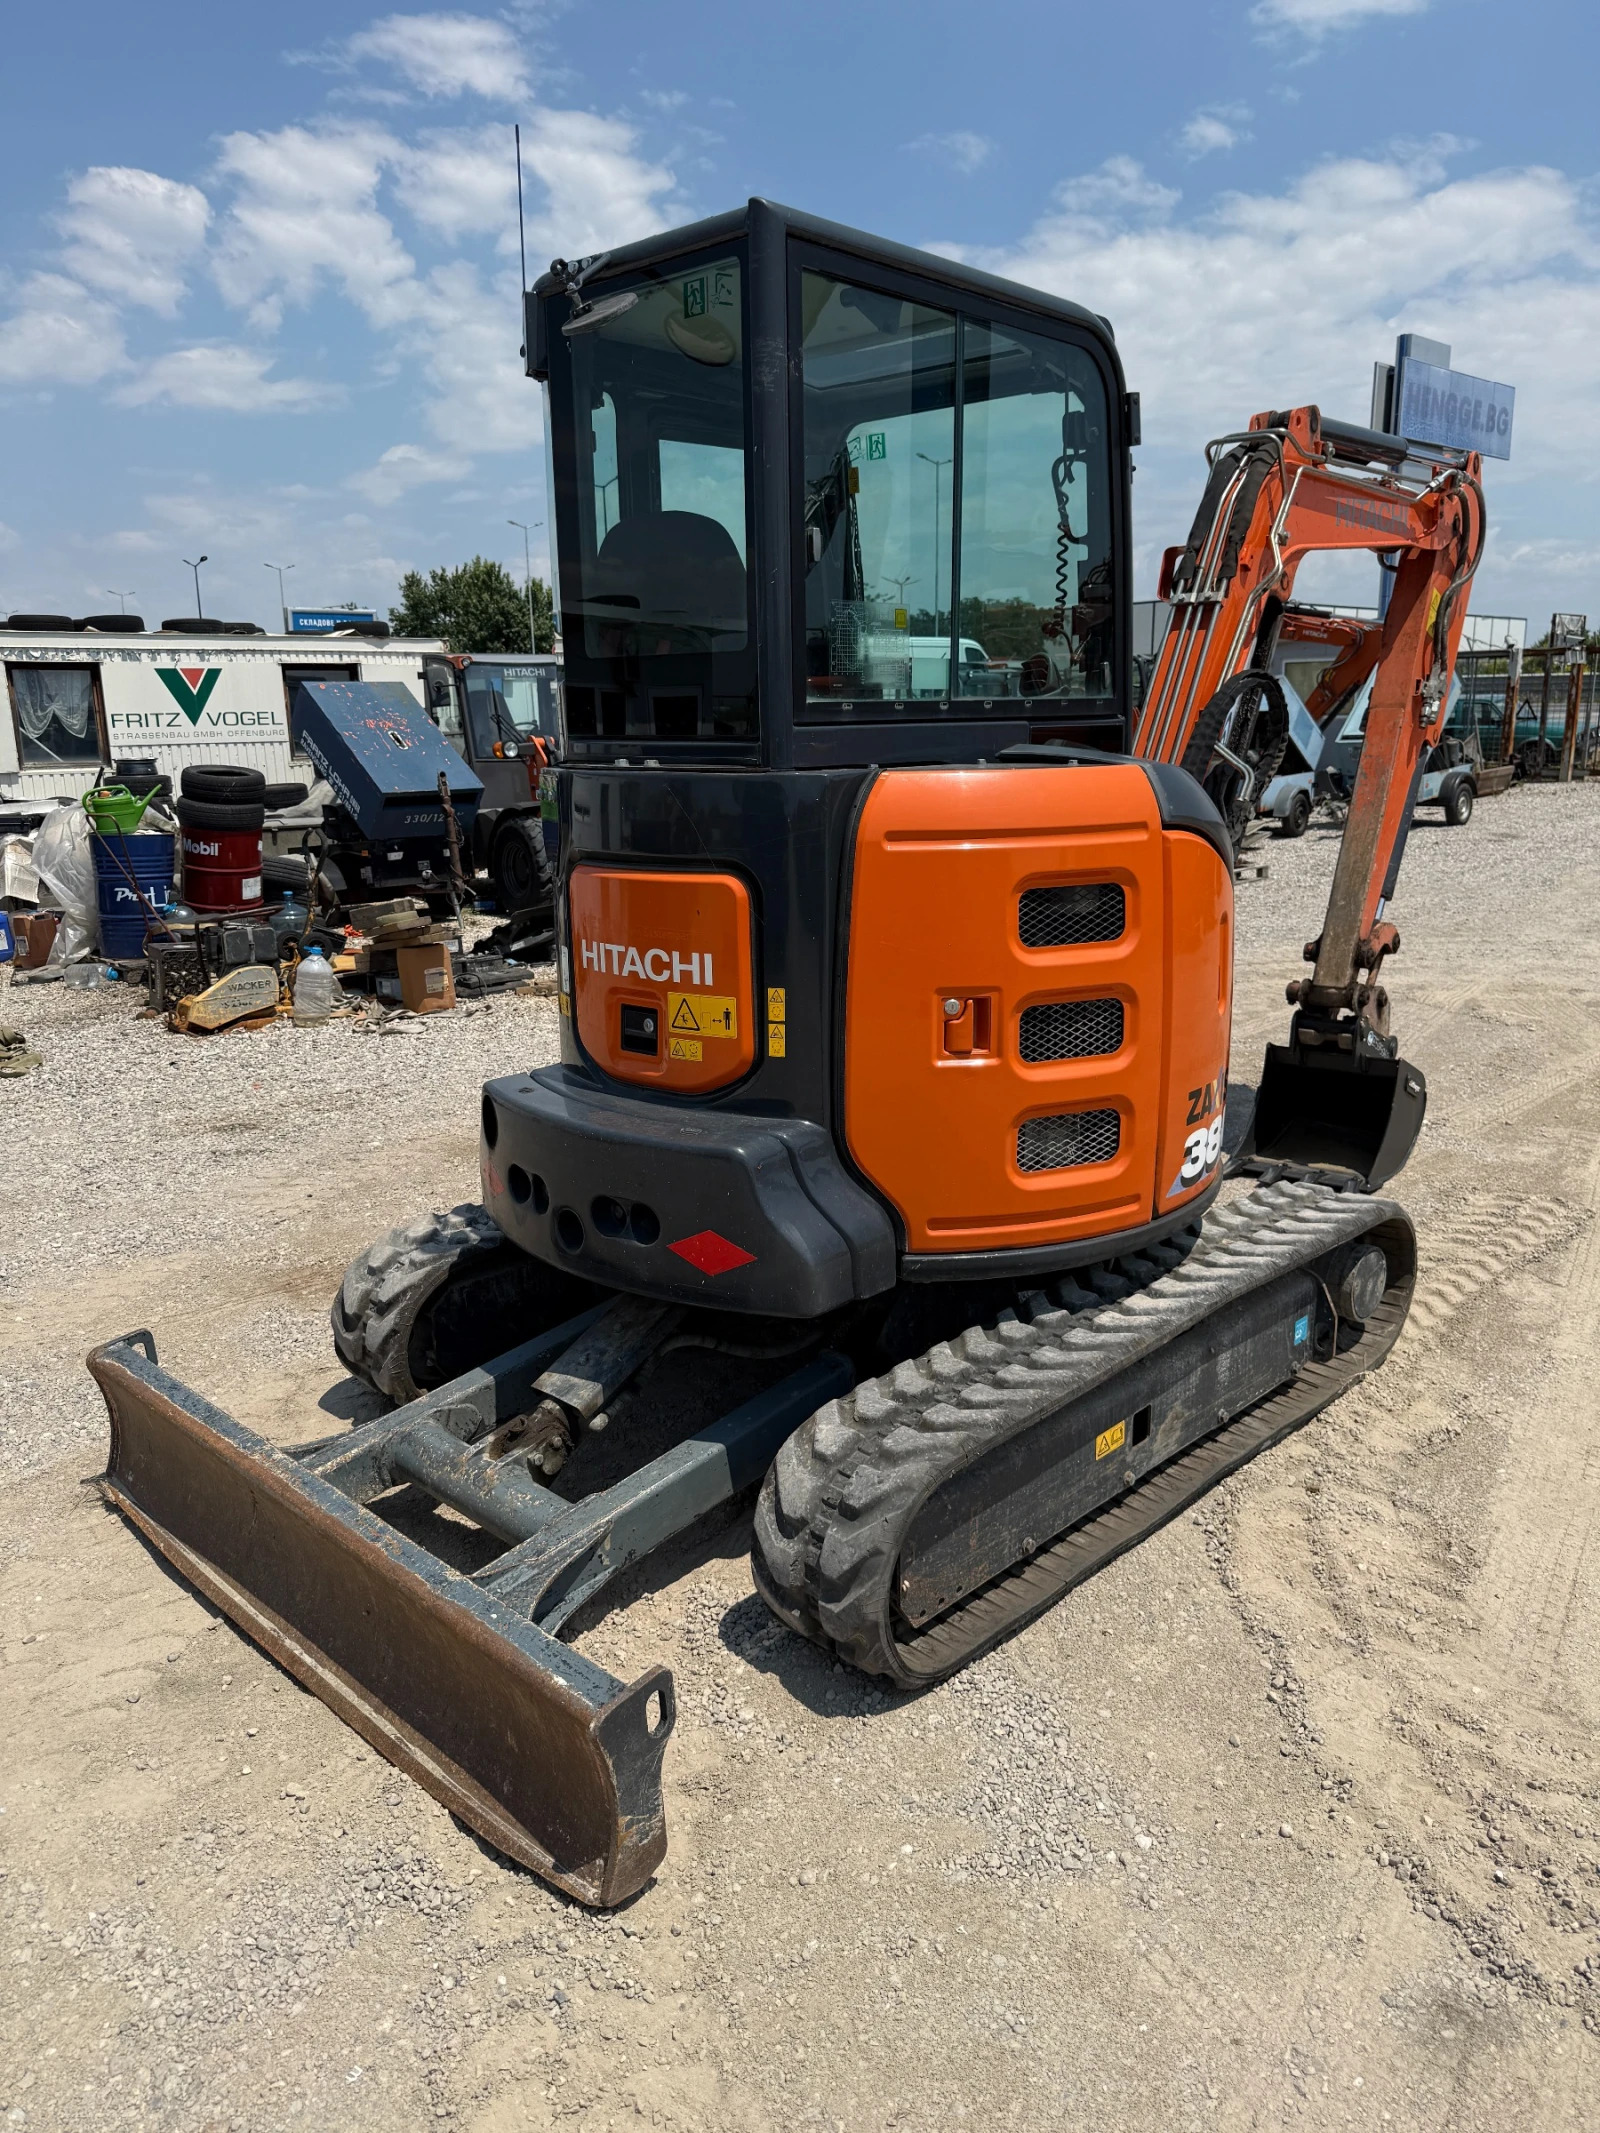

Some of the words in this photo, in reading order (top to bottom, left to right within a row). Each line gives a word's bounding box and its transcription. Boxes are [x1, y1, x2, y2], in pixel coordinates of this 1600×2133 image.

[1405, 381, 1510, 436] HENGGE.BG
[1335, 497, 1409, 534] HITACHI
[299, 618, 335, 627] СКЛАДОВЕ
[503, 667, 546, 677] HITACHI
[110, 712, 182, 728] FRITZ
[206, 711, 283, 726] VOGEL
[113, 731, 190, 740] STRASSENBAU
[193, 730, 222, 738] GMBH
[227, 729, 286, 738] OFFENBURG
[183, 838, 218, 856] Mobil
[581, 938, 713, 986] HITACHI
[228, 980, 271, 992] WACKER
